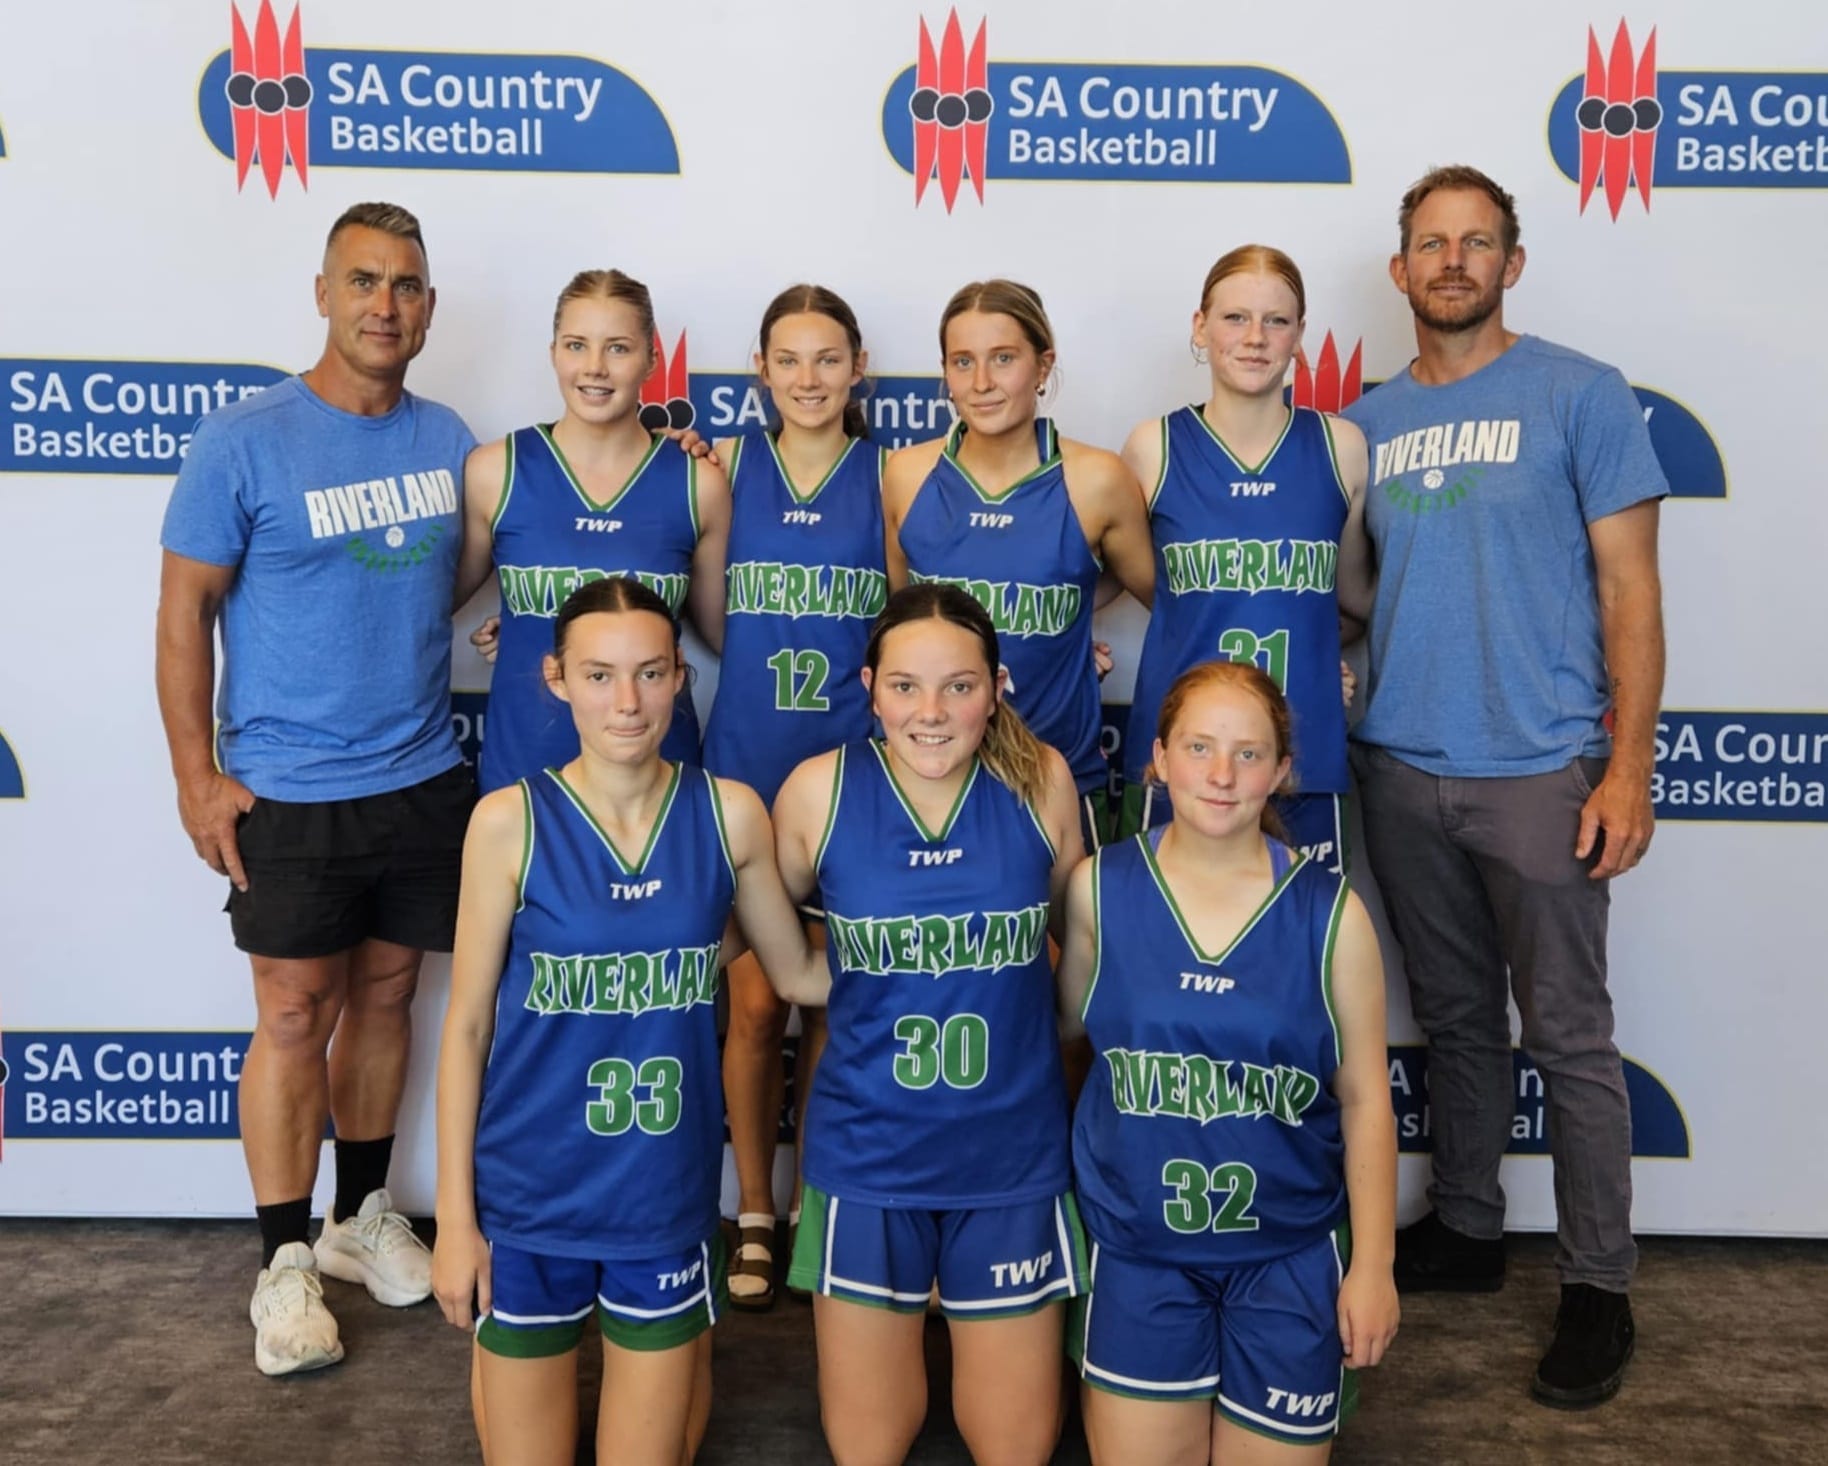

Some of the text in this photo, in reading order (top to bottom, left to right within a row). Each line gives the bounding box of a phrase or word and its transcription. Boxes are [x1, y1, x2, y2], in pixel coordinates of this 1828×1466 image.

[328, 62, 603, 121] SA Country
[1008, 76, 1279, 132] SA Country
[1677, 84, 1738, 126] SA
[330, 116, 543, 156] Basketball
[1009, 128, 1217, 166] Basketball
[10, 371, 266, 415] SA Countr
[710, 386, 768, 426] SA
[1374, 419, 1520, 486] RIVERLAND
[304, 468, 457, 539] RIVERLAND
[1229, 482, 1276, 497] TWP
[574, 517, 623, 533] TWP
[782, 510, 822, 525] TWP
[969, 512, 1014, 529] TWP
[725, 560, 887, 620] IVERLAND
[767, 648, 830, 711] 12
[1653, 723, 1703, 762] SA
[908, 848, 963, 867] TWP
[610, 879, 661, 900] TWP
[1180, 972, 1235, 994] TWP
[24, 1042, 249, 1082] SA Count
[893, 1013, 989, 1090] 30
[26, 1089, 229, 1124] Basketball
[586, 1056, 683, 1136] 33
[1162, 1158, 1259, 1234] 32
[657, 1260, 701, 1290] TWP
[989, 1251, 1053, 1288] TWP
[1266, 1387, 1335, 1416] TWP
